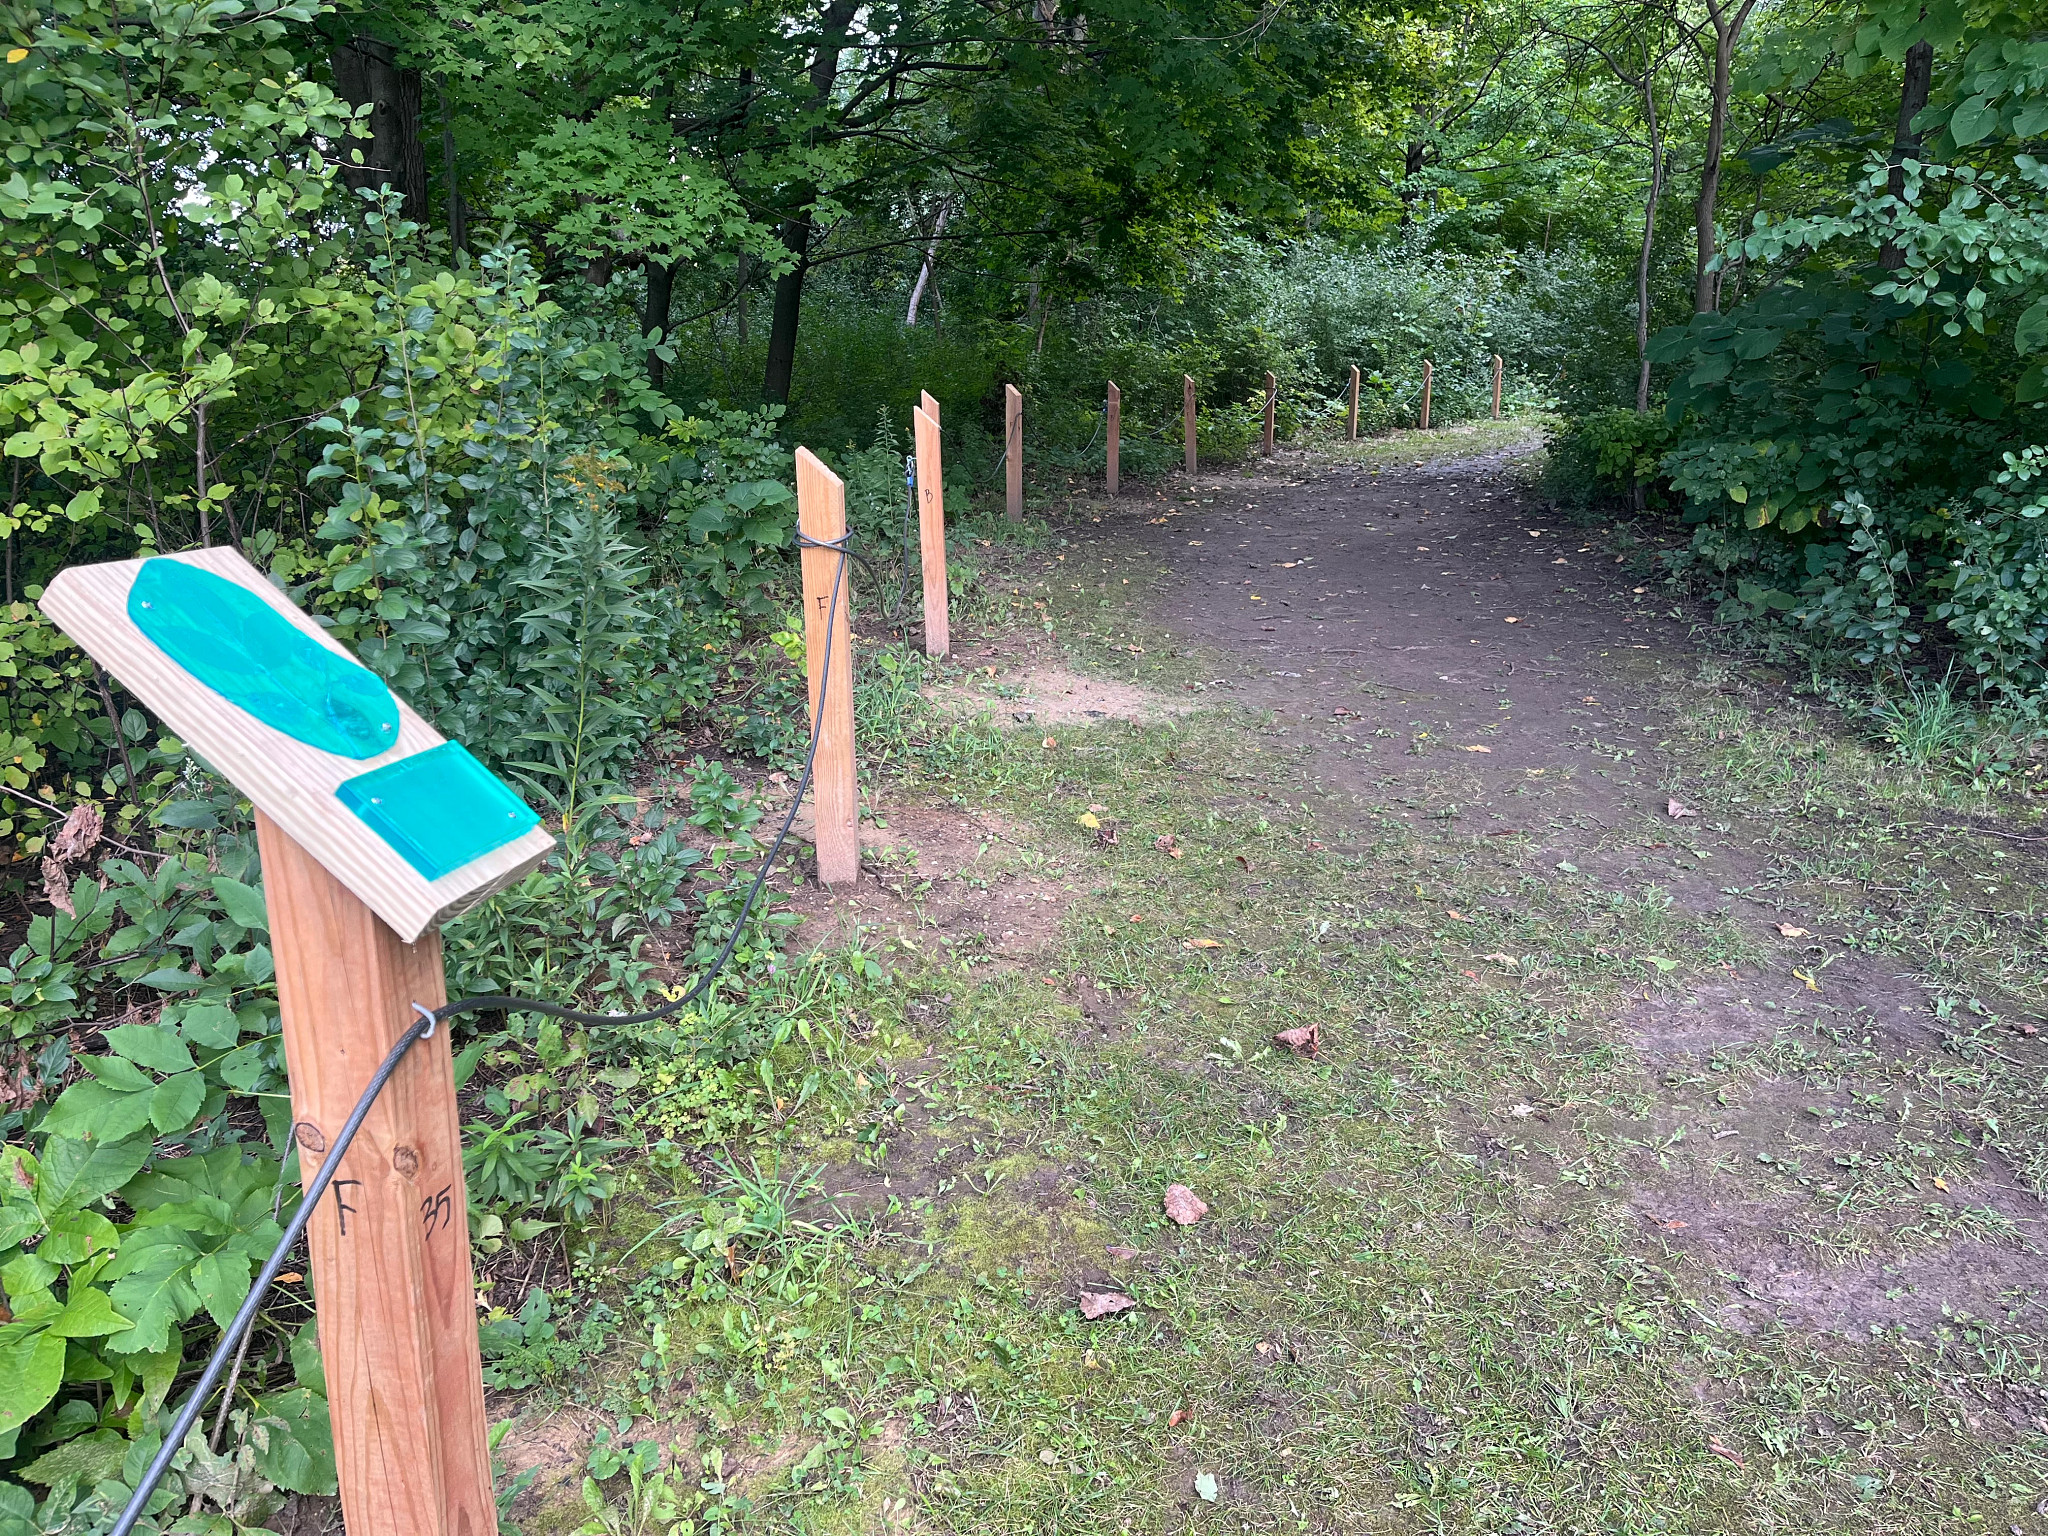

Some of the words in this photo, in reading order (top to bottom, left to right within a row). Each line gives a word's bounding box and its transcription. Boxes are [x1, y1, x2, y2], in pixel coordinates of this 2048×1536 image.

[816, 595, 829, 620] F
[331, 1179, 362, 1237] F
[420, 1184, 452, 1241] 35
